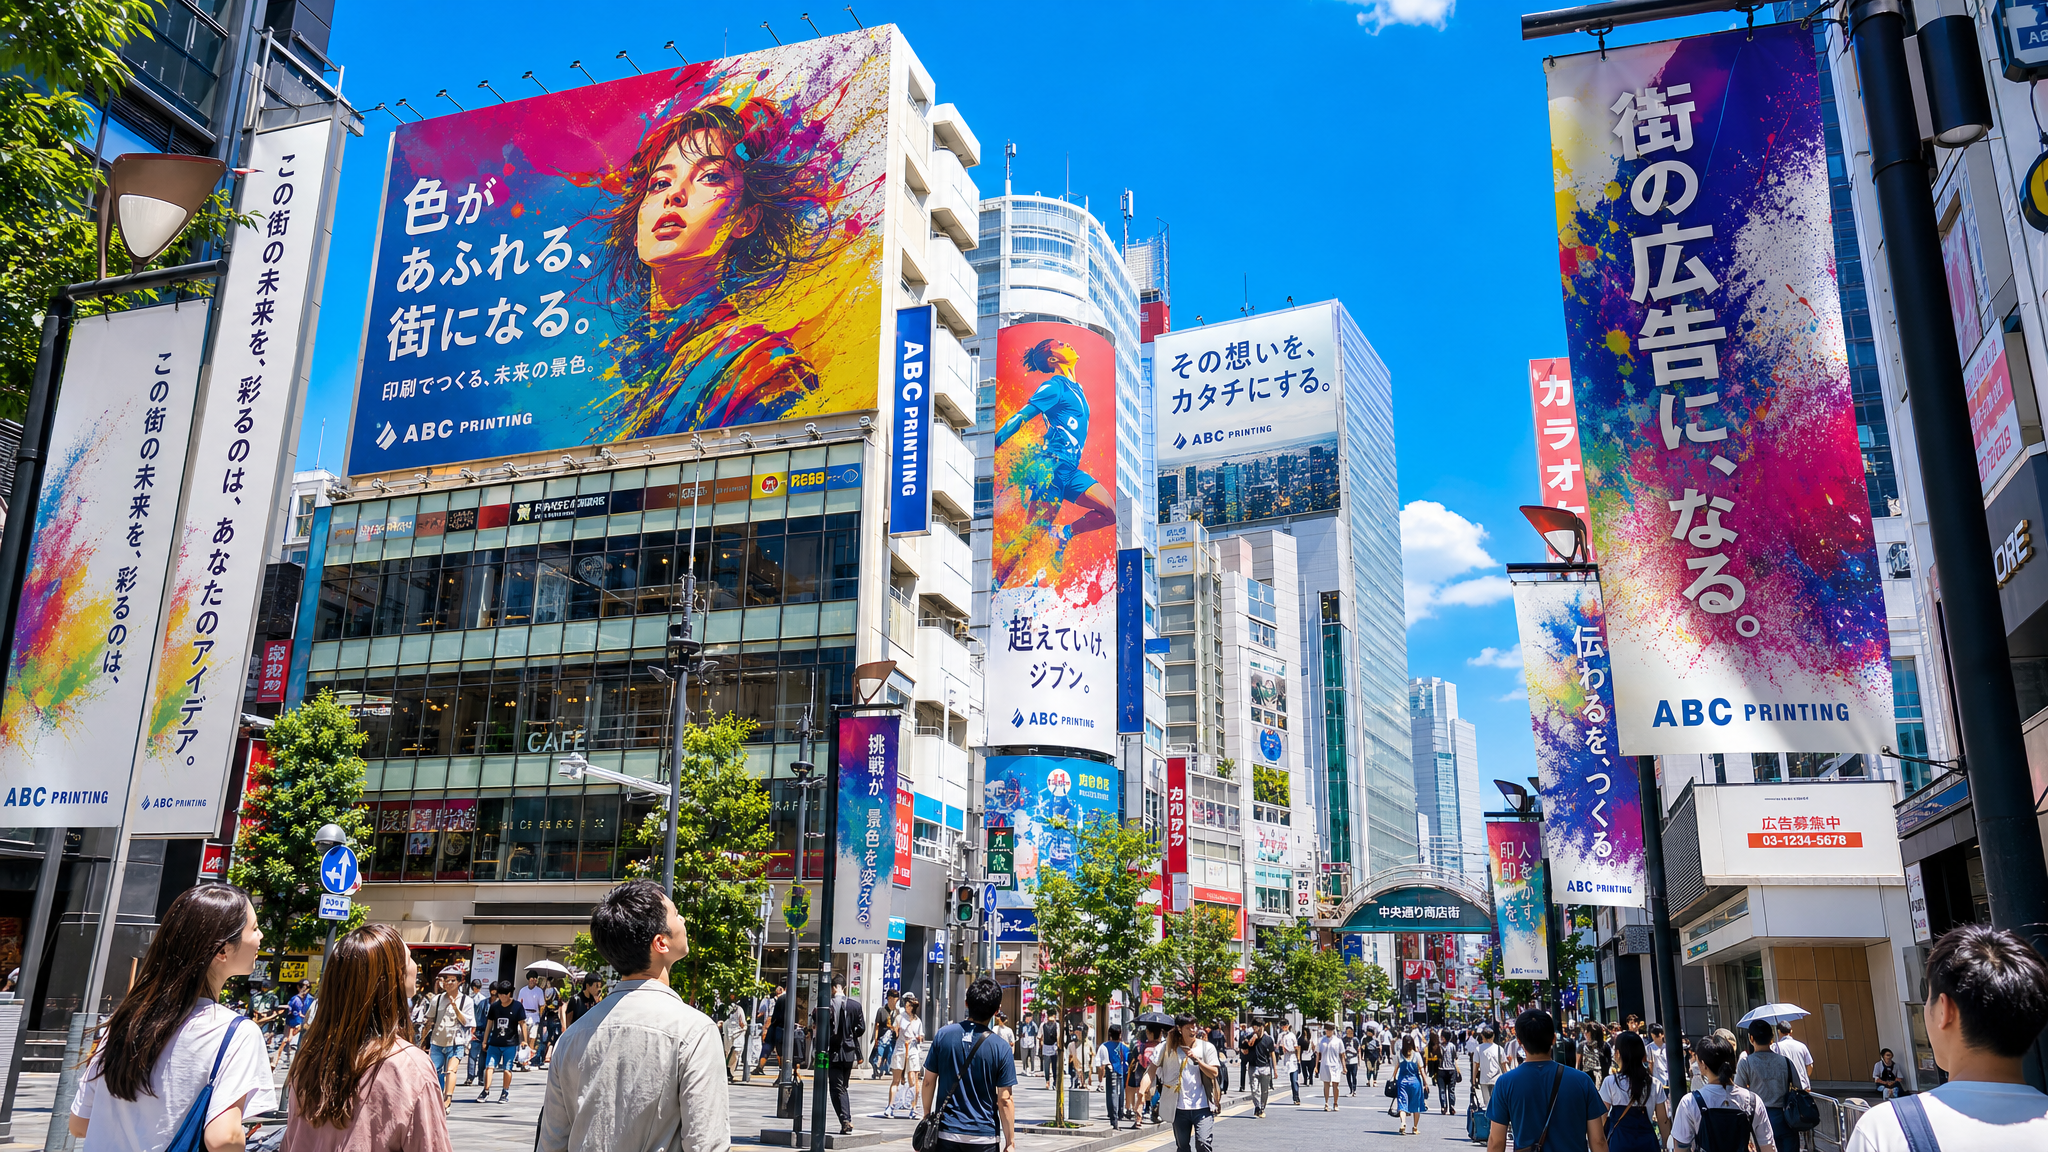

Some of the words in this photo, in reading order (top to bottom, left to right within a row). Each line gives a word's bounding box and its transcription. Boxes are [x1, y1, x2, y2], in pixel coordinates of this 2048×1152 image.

[404, 177, 496, 235] 色が
[396, 226, 592, 293] あふれる、
[387, 290, 589, 361] 街になる。
[382, 355, 593, 401] 印刷でつくる、未来の景色。
[903, 341, 923, 401] ABC
[1171, 334, 1315, 380] その想いを、
[1610, 82, 1760, 638] 街の広告に、なる。
[1171, 367, 1330, 415] カタチにする。
[403, 420, 453, 443] ABC
[460, 413, 533, 433] PRINTING
[1192, 430, 1224, 445] ABC
[1228, 425, 1272, 439] PRINTING
[175, 154, 296, 766] この街の未来を、彩るのは、あなたのアイデア。
[902, 407, 918, 496] PRINTING
[102, 352, 173, 684] この街の未来を、彩るのは、
[1008, 615, 1107, 659] 超えていけ、
[1030, 663, 1090, 694] ジブン。
[1029, 712, 1058, 726] ABC
[1061, 717, 1095, 728] PRINTING
[1652, 698, 1732, 727] ABC
[1744, 703, 1849, 722] PRINTING
[527, 729, 589, 752] CAFE
[1572, 625, 1617, 870] 伝わるを、つくる。
[3, 787, 46, 807] ABC
[51, 790, 108, 804] PRINTING
[153, 797, 173, 809] ABC
[175, 798, 207, 807] PRINTING
[857, 734, 885, 929] 挑戦が、景色を変える。
[1763, 835, 1847, 846] 03-1234-5678
[1567, 880, 1593, 894] ABC
[1596, 883, 1632, 894] PRINTING
[1379, 906, 1460, 919] 中央通り商店街
[838, 937, 857, 945] ABC
